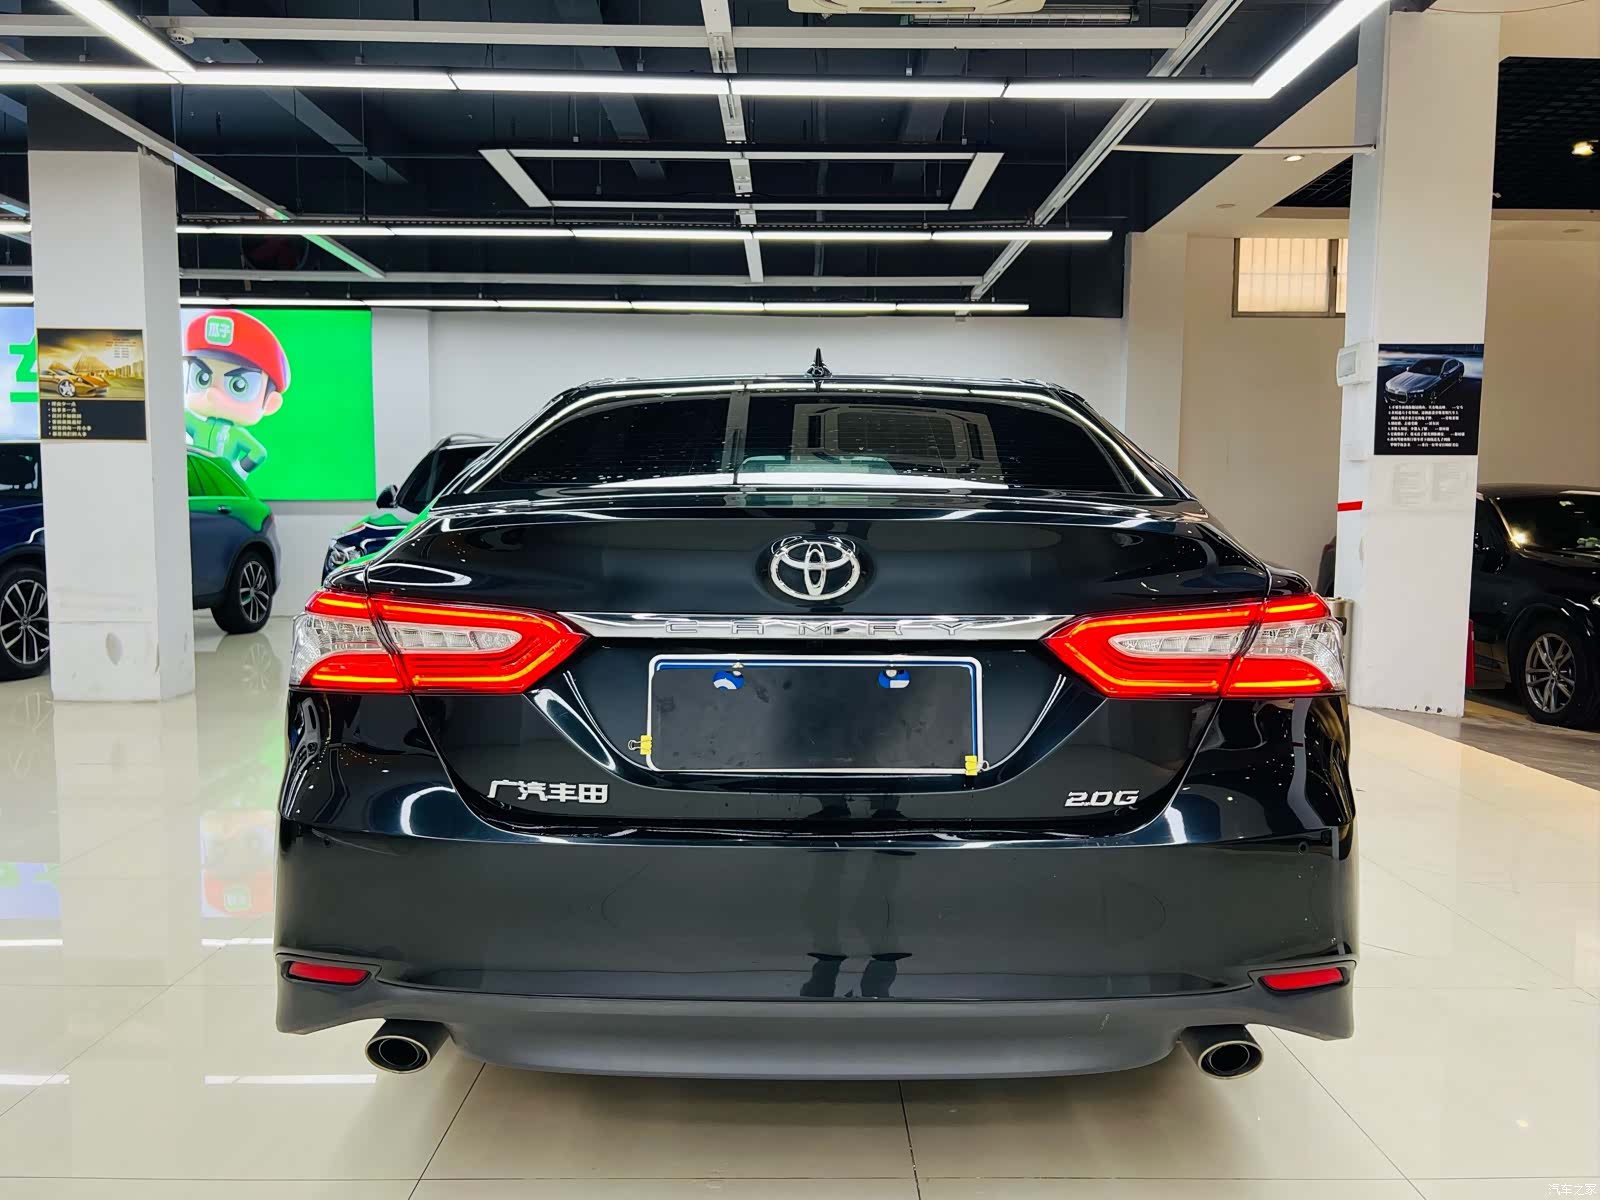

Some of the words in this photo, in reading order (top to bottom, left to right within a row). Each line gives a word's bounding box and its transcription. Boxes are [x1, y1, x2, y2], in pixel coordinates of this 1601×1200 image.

[664, 619, 968, 635] CAMRY
[487, 779, 609, 804] 广汽丰田
[1064, 790, 1140, 807] 2.0G
